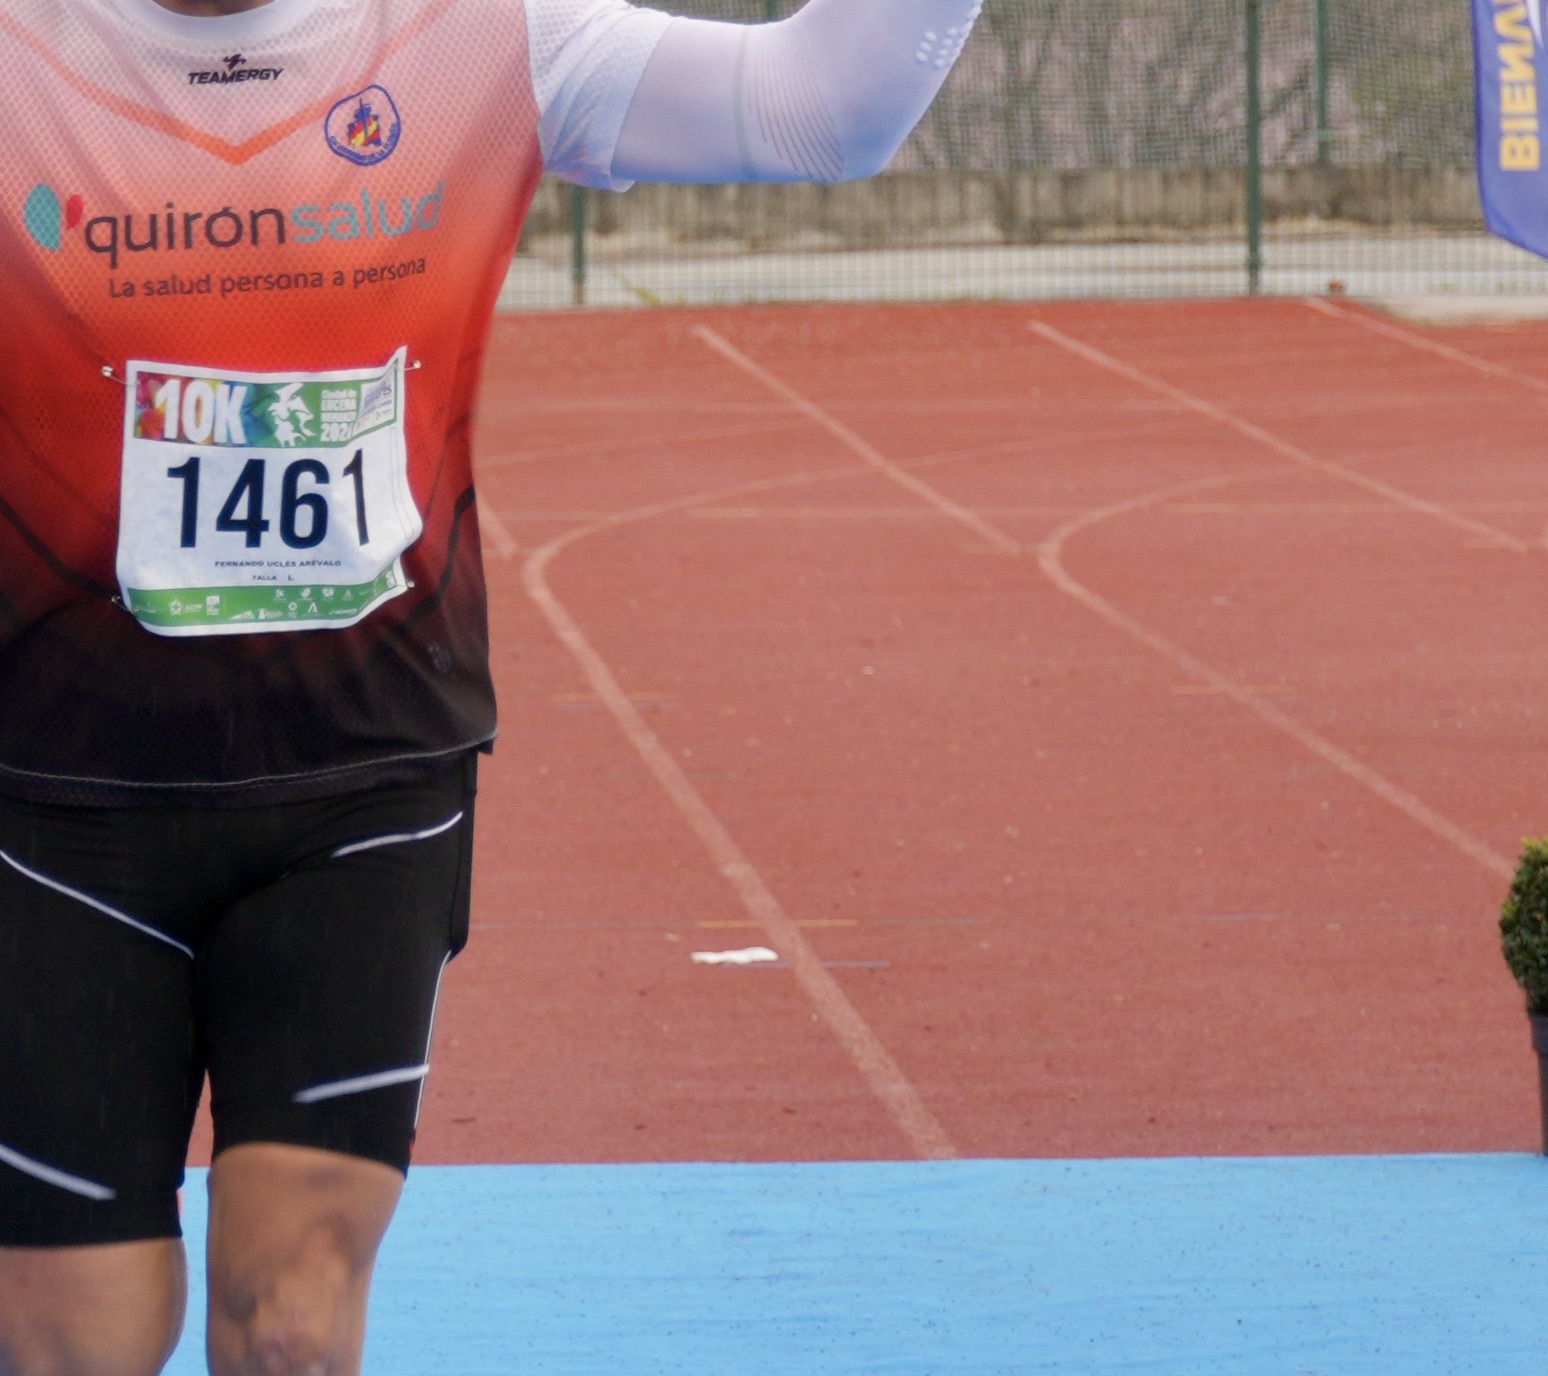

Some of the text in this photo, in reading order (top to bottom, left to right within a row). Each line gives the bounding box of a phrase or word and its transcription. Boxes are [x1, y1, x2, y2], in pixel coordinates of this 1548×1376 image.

[188, 68, 285, 85] TEAMERGY
[84, 179, 446, 270] quirónsalud
[109, 258, 427, 299] La salud persona a persona
[155, 378, 248, 445] 10K
[167, 448, 370, 550] 1461
[214, 559, 342, 568] FERNANDO UCLÉS ARÉVALO
